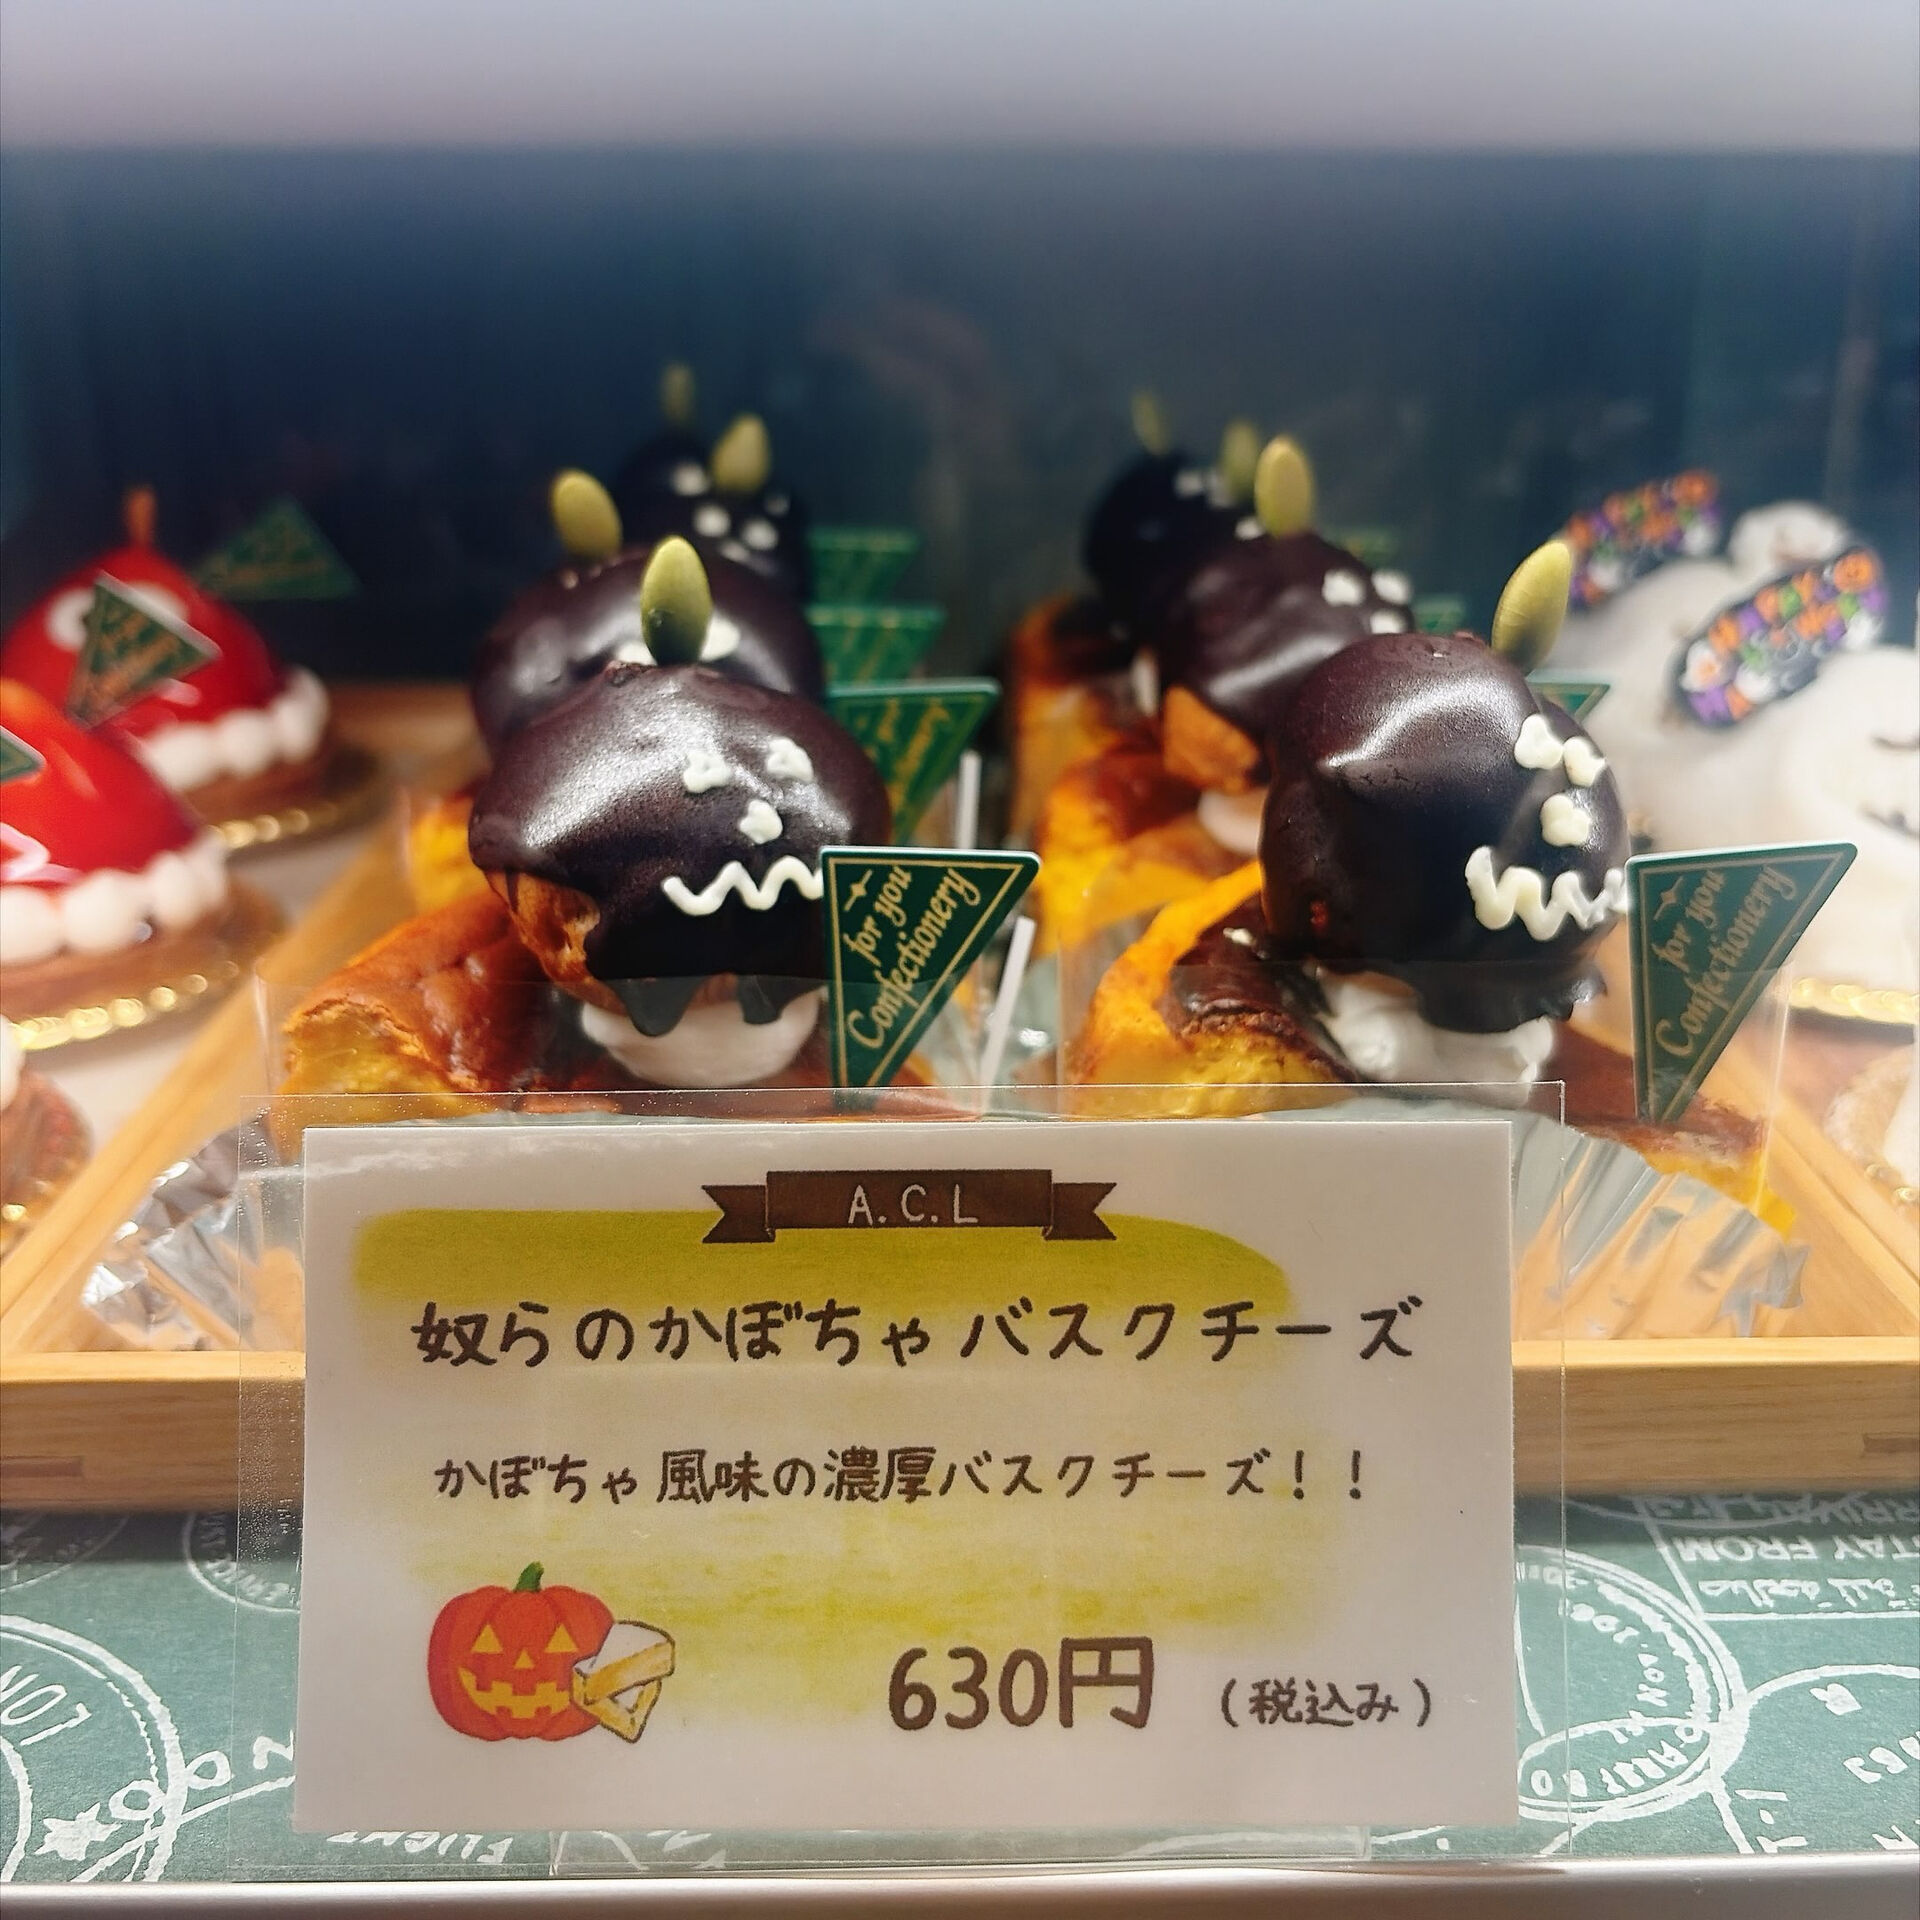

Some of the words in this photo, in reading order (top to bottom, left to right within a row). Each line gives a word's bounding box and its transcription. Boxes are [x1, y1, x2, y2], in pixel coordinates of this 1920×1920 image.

[843, 915, 882, 968] for
[874, 866, 912, 927] you
[847, 866, 981, 1049] Confectionery
[1652, 920, 1691, 974] for
[1685, 868, 1726, 929] you
[1655, 864, 1798, 1058] Confectionery
[847, 1185, 979, 1225] A.C.L
[411, 1295, 1423, 1367] 奴らのかぼちゃバスクチーズ
[433, 1445, 1363, 1505] かぼちゃ風味の濃厚バスクチーズ！！
[889, 1636, 1155, 1731] 630円
[1220, 1677, 1432, 1729] （税込み）
